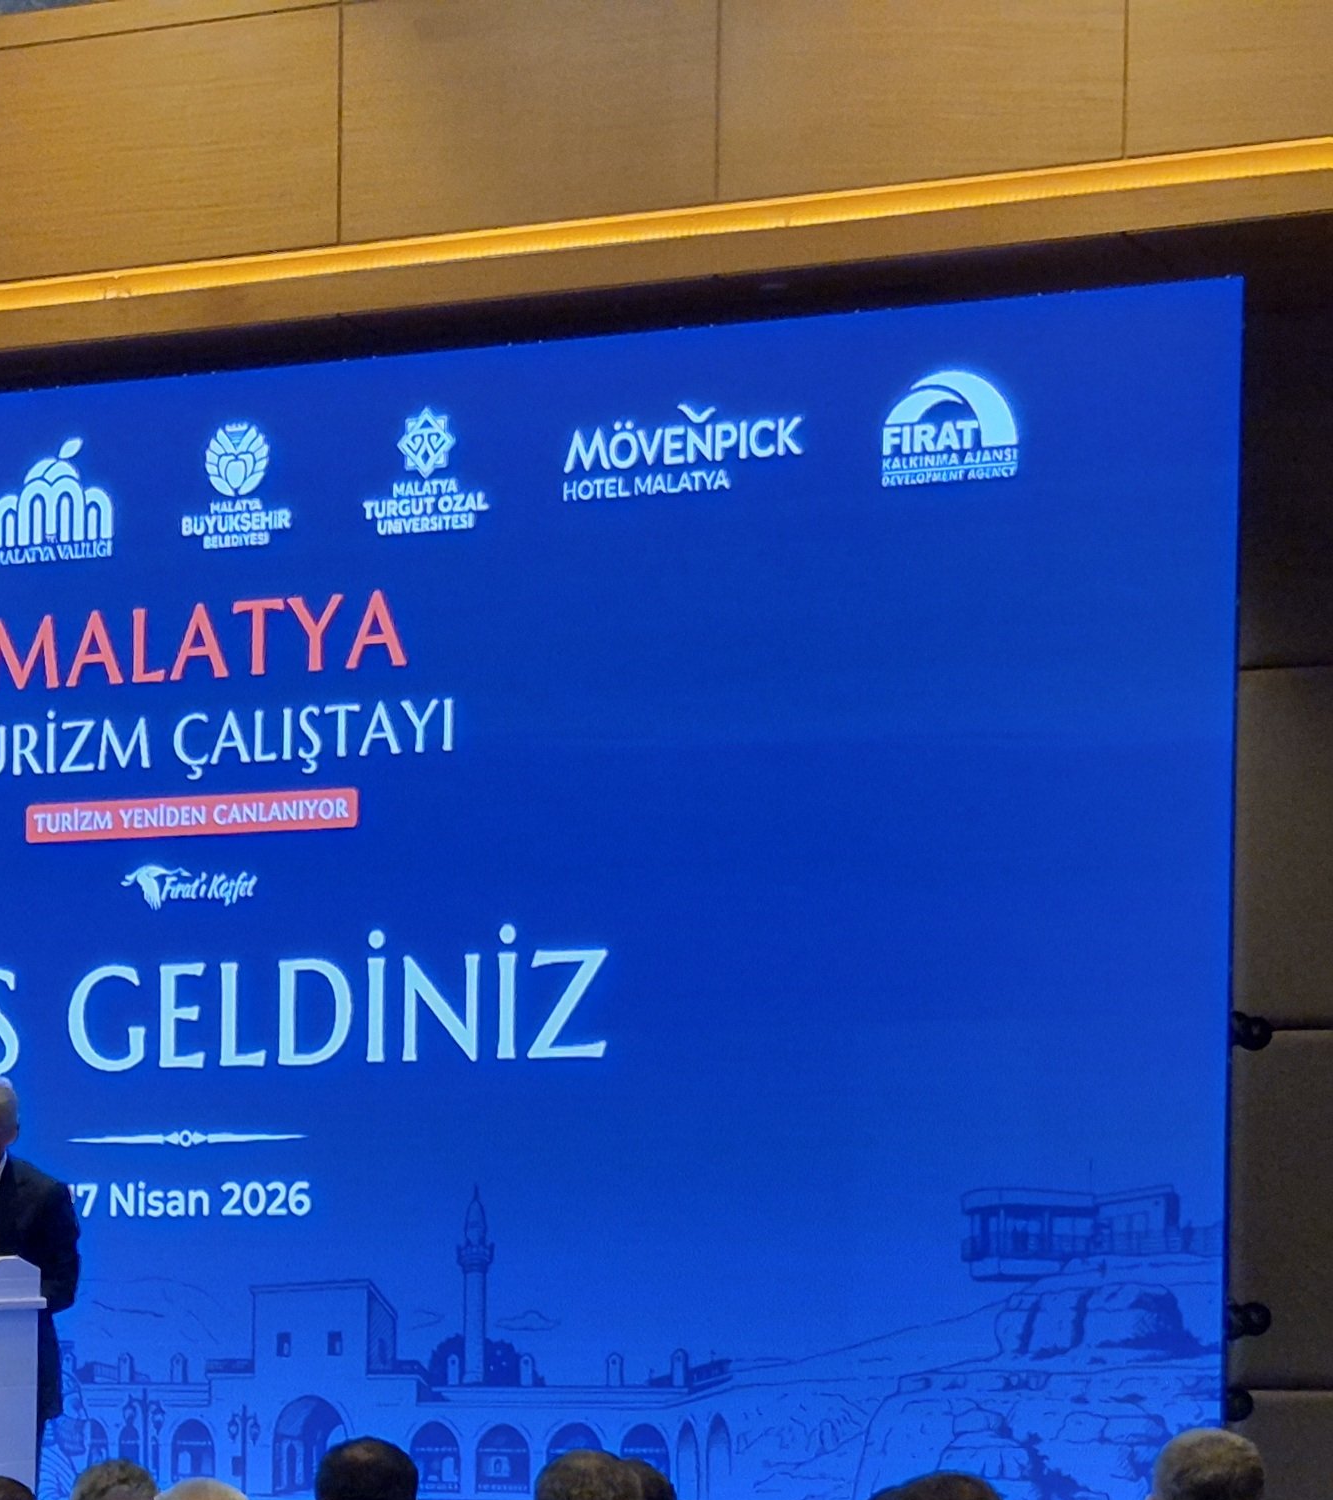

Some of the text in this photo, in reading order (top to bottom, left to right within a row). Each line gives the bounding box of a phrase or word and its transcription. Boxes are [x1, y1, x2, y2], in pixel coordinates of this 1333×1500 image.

[564, 415, 804, 473] MÖVENPICK
[882, 420, 979, 456] FIRAT
[882, 453, 959, 471] KALKINMA
[393, 478, 458, 498] MALATYA
[563, 469, 731, 501] HOTEL MALATYA
[363, 497, 435, 520] TURGUT
[173, 697, 456, 780] ÇALIŞTAYI
[34, 798, 349, 833] TURİZM YENİDEN CANLANIYOR
[67, 923, 609, 1073] GELDİNİZ
[109, 1181, 210, 1218] Nisan
[220, 1181, 312, 1217] 2026
